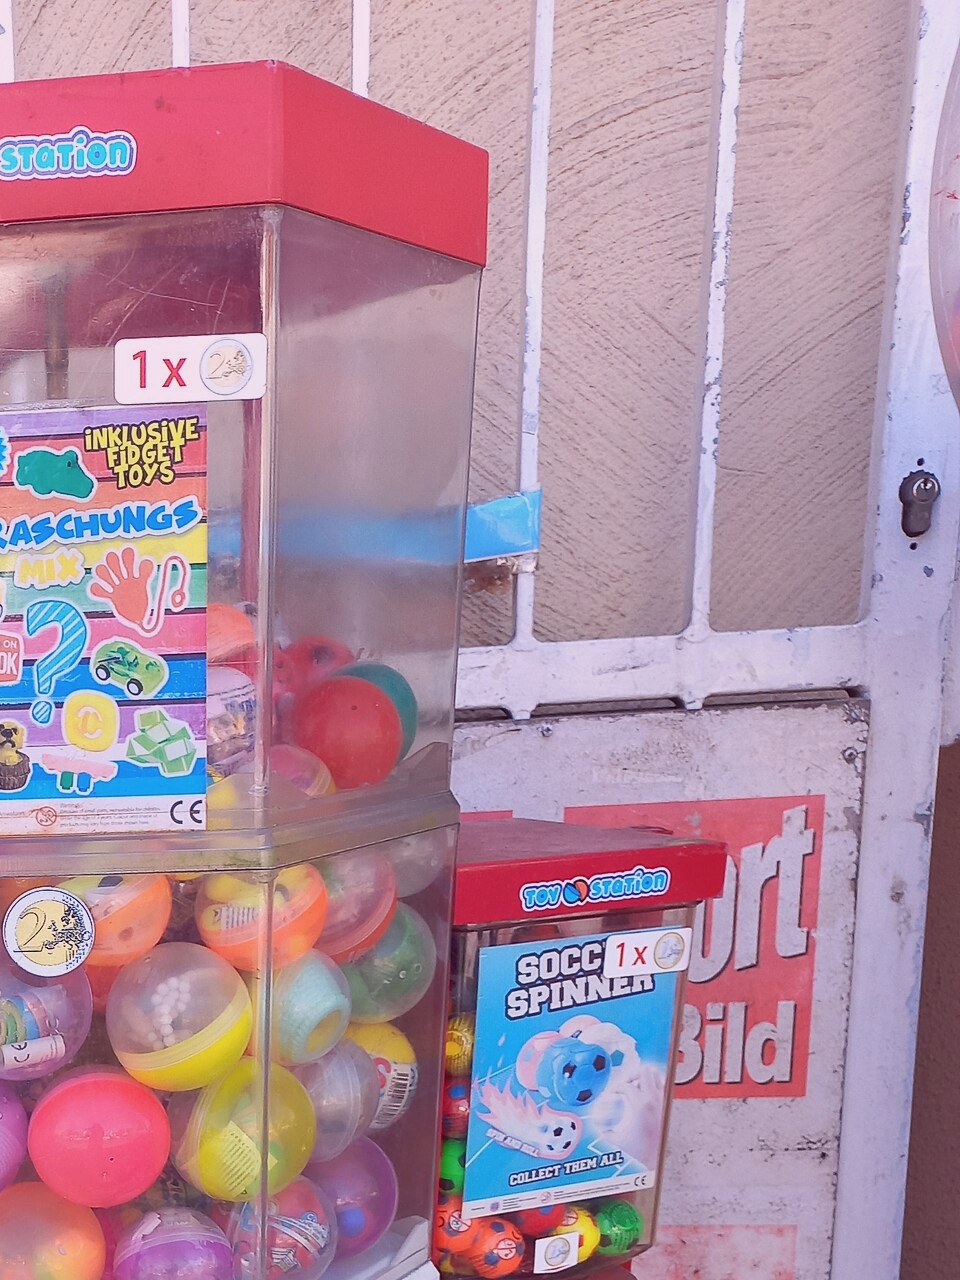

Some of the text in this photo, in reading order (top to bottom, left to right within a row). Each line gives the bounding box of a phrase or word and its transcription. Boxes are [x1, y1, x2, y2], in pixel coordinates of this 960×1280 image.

[132, 350, 147, 389] 1
[162, 357, 188, 388] x
[113, 461, 176, 490] TOYS
[18, 552, 86, 584] MIX
[3, 640, 18, 649] ON
[616, 942, 626, 967] 1
[632, 946, 647, 966] x
[508, 1151, 624, 1187] COLLECT THEM ALL
